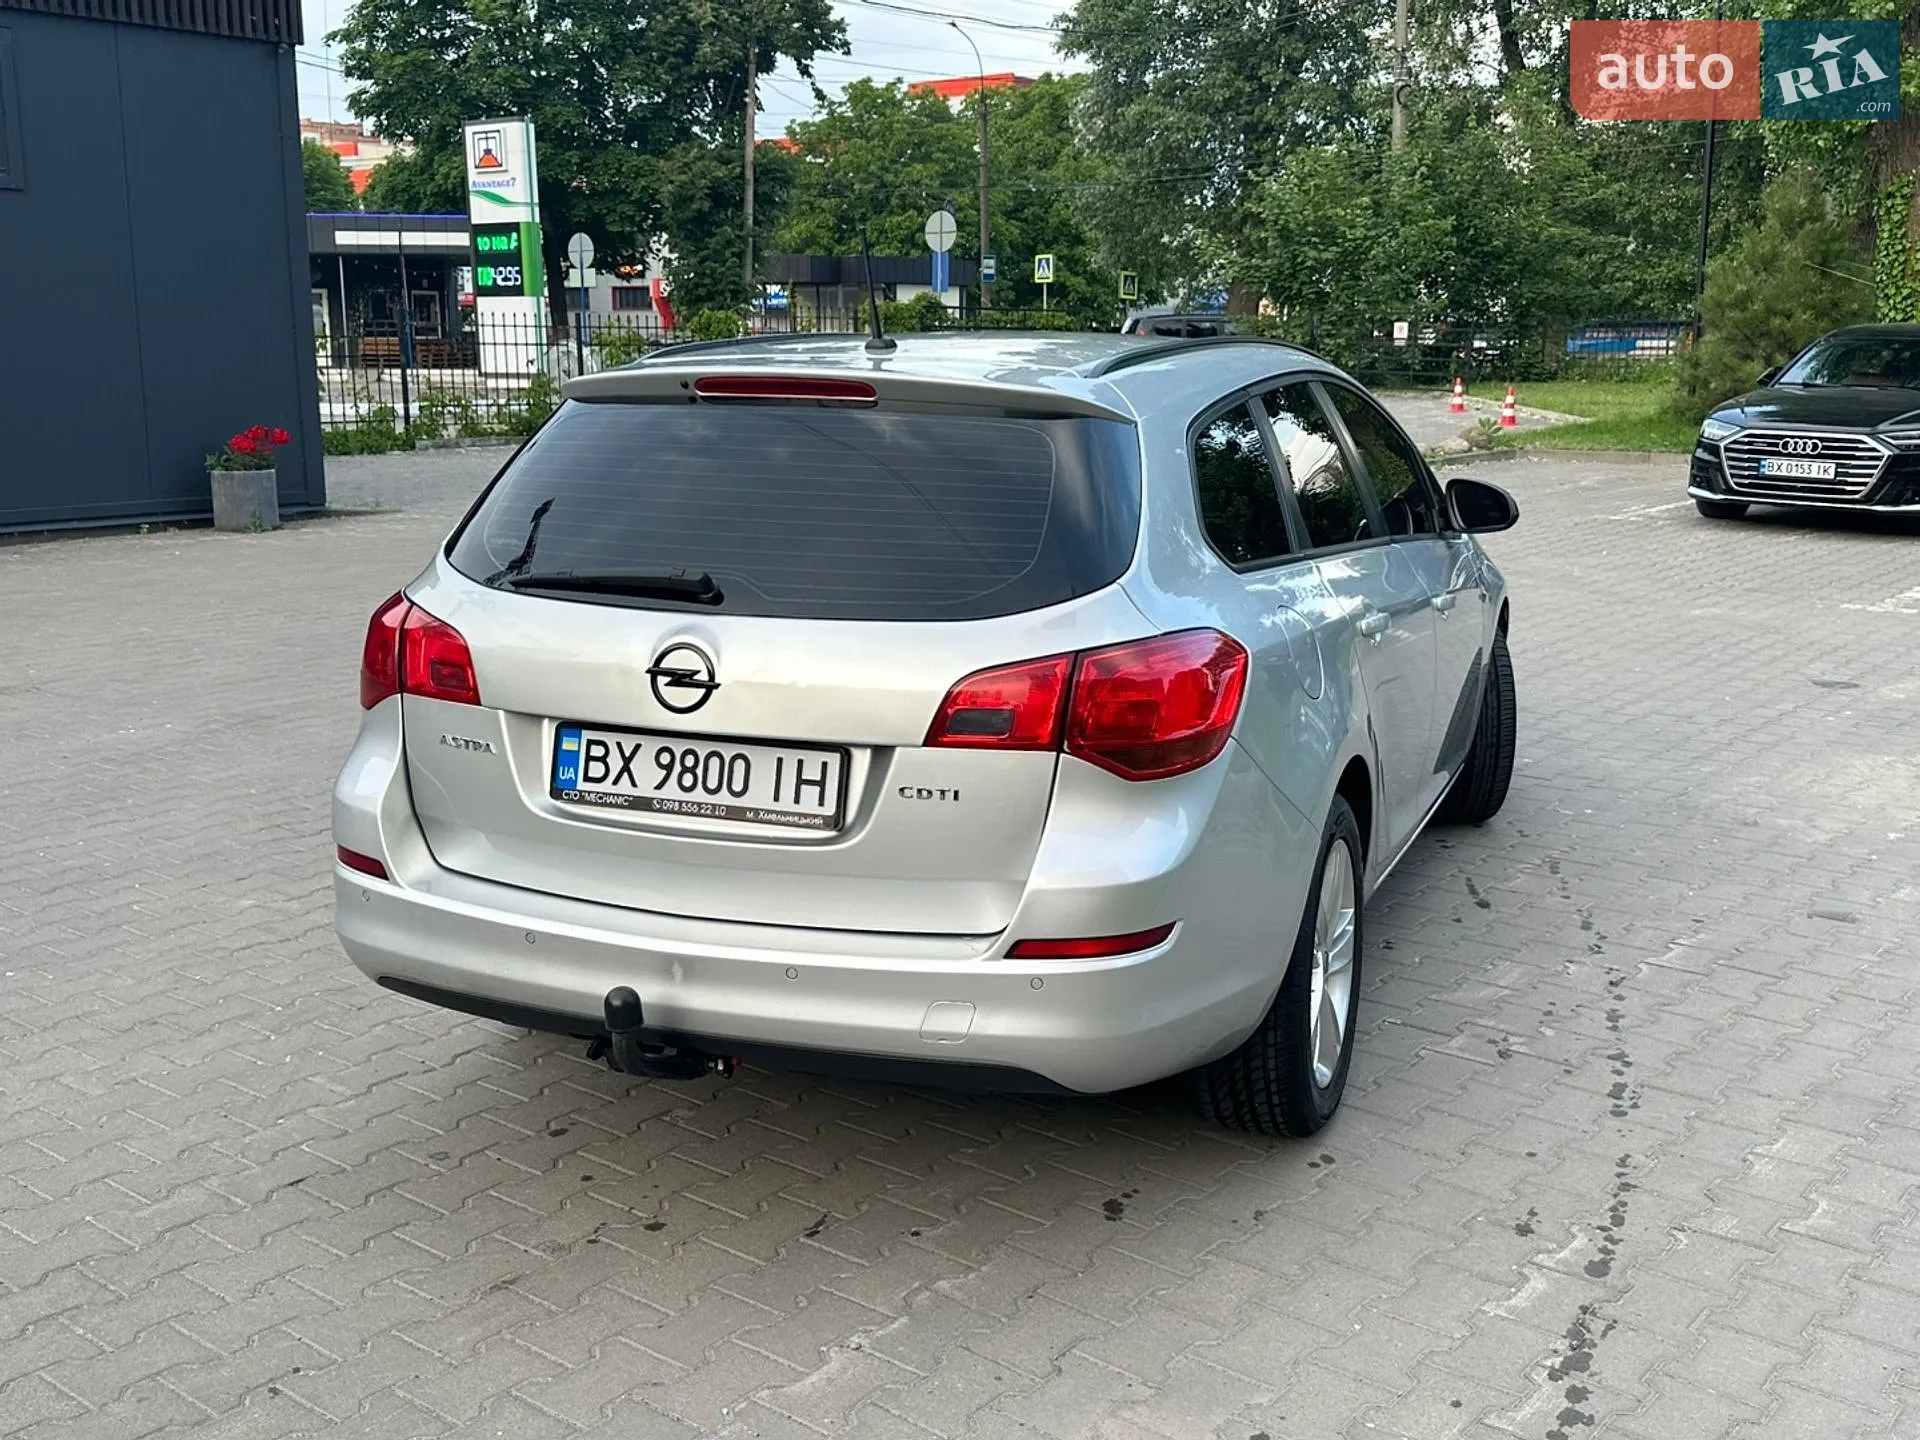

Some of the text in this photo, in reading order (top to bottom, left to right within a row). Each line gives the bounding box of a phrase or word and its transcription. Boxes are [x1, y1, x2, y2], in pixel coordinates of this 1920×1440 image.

[1767, 461, 1784, 473] BX
[1785, 463, 1813, 475] 0153
[439, 734, 497, 755] ASTRA
[559, 766, 576, 780] UA
[583, 738, 828, 807] BX 9800 IH
[898, 786, 960, 801] CDTI
[662, 800, 679, 811] 098
[700, 803, 712, 814] 22
[714, 805, 728, 816] 10
